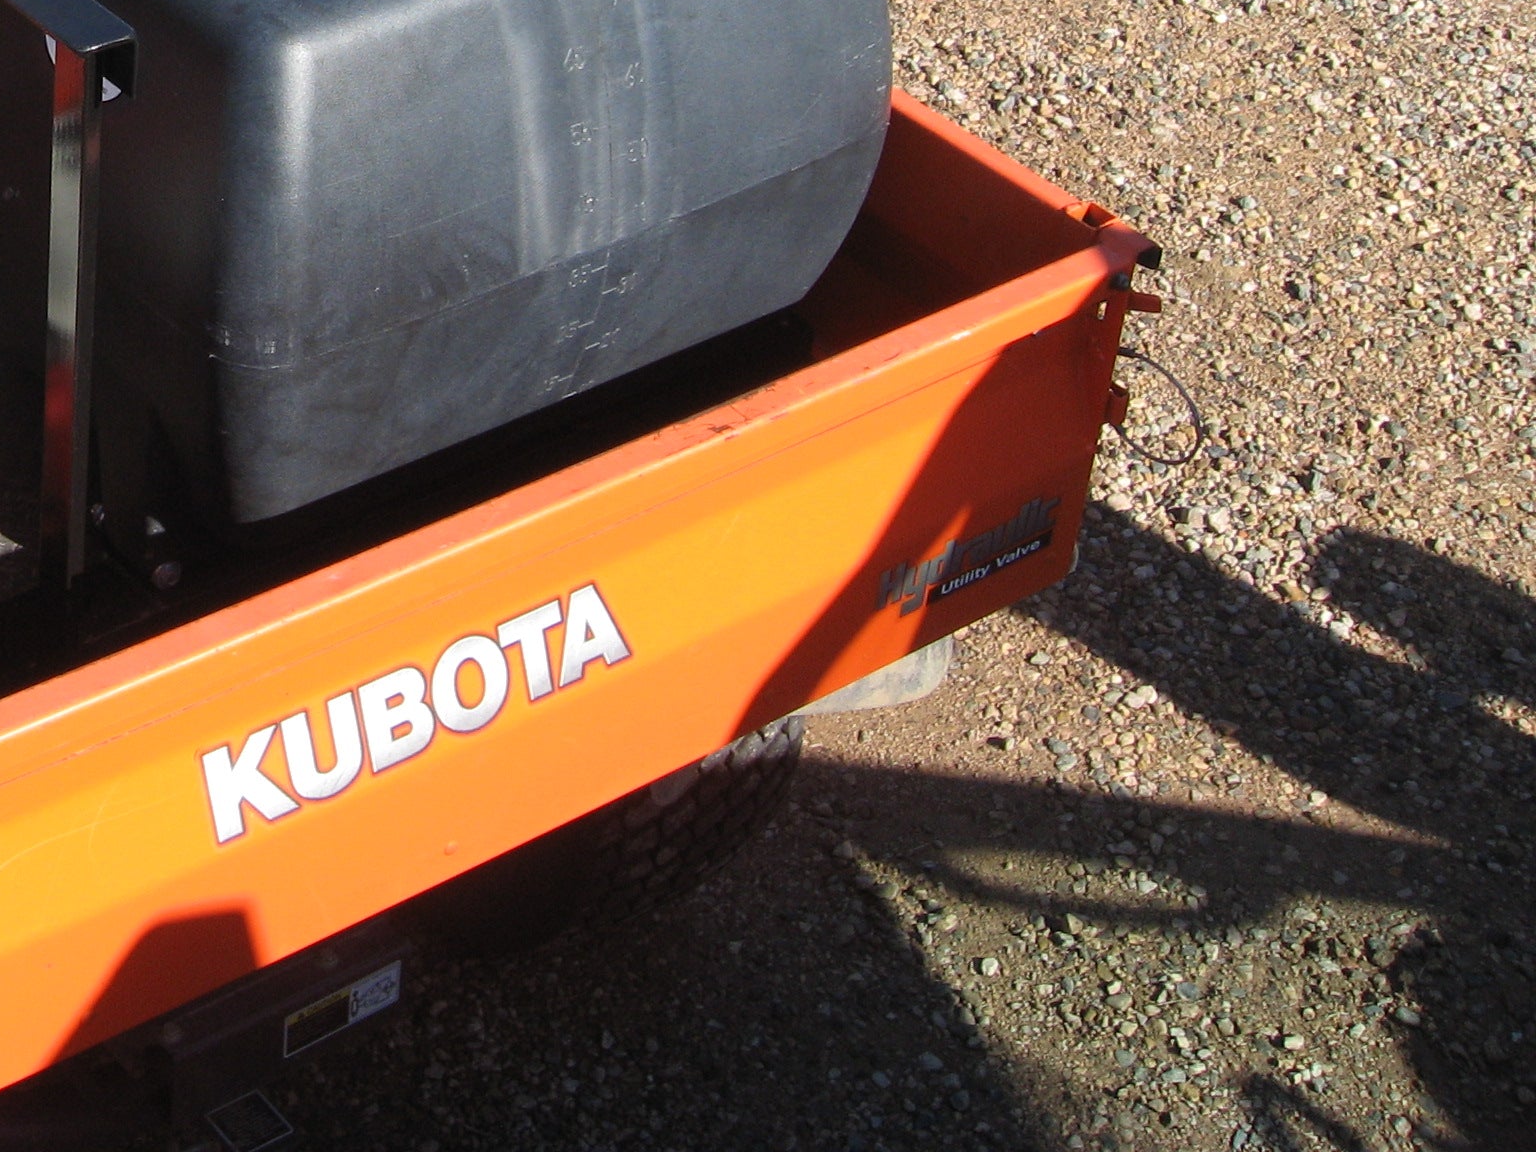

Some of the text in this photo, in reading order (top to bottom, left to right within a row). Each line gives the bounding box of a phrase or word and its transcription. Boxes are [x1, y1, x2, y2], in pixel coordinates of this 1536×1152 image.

[940, 539, 1042, 595] Utility Valve
[200, 583, 632, 845] KUBOTA
